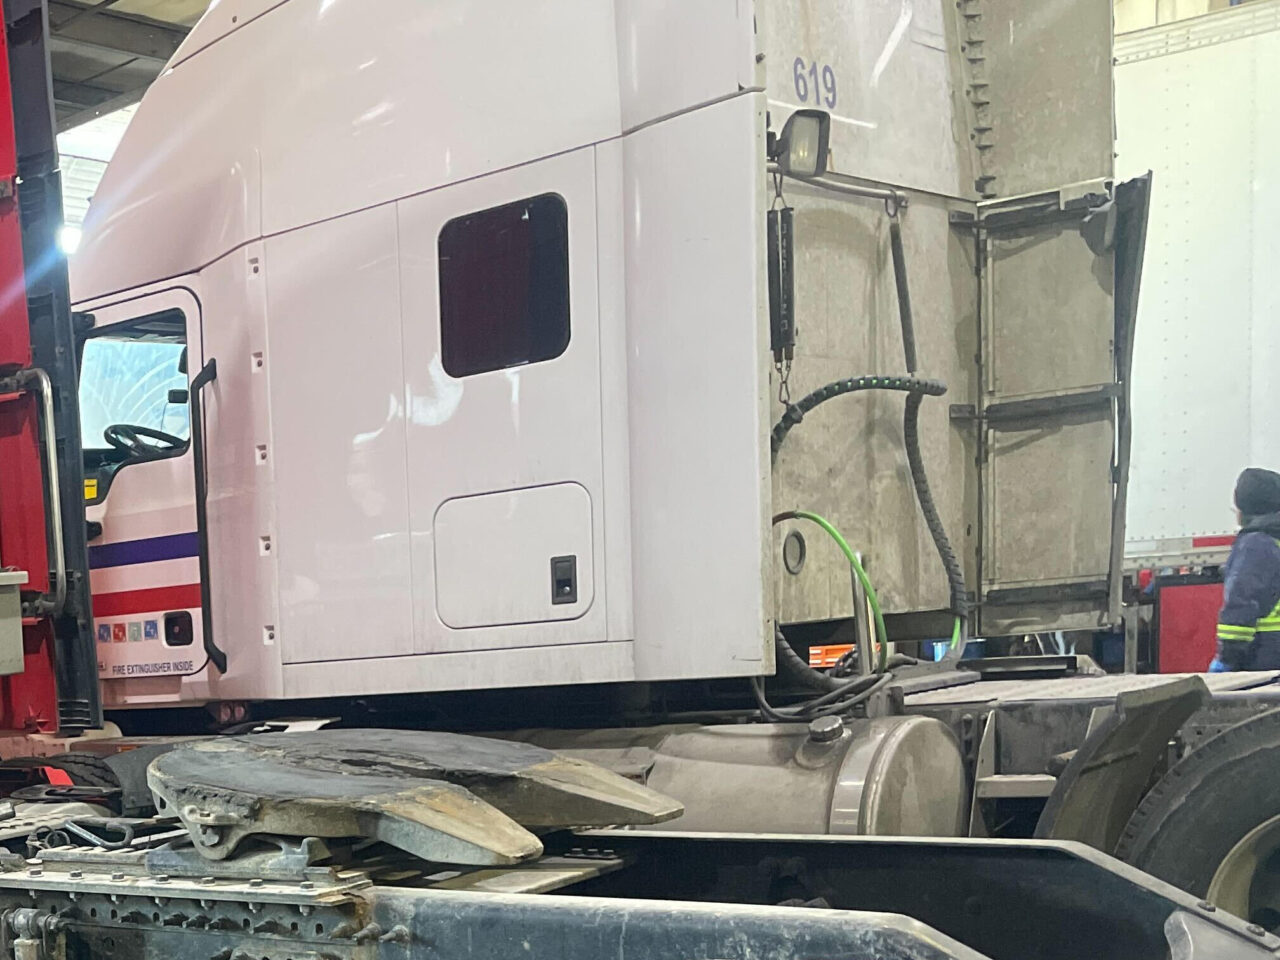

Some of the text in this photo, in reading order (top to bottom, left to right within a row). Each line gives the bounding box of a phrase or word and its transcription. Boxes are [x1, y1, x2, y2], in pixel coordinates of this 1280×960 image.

[793, 57, 836, 109] 619
[112, 664, 126, 676] FIRE
[127, 662, 172, 674] EXTINGUISHER
[172, 660, 194, 672] INSIDE
